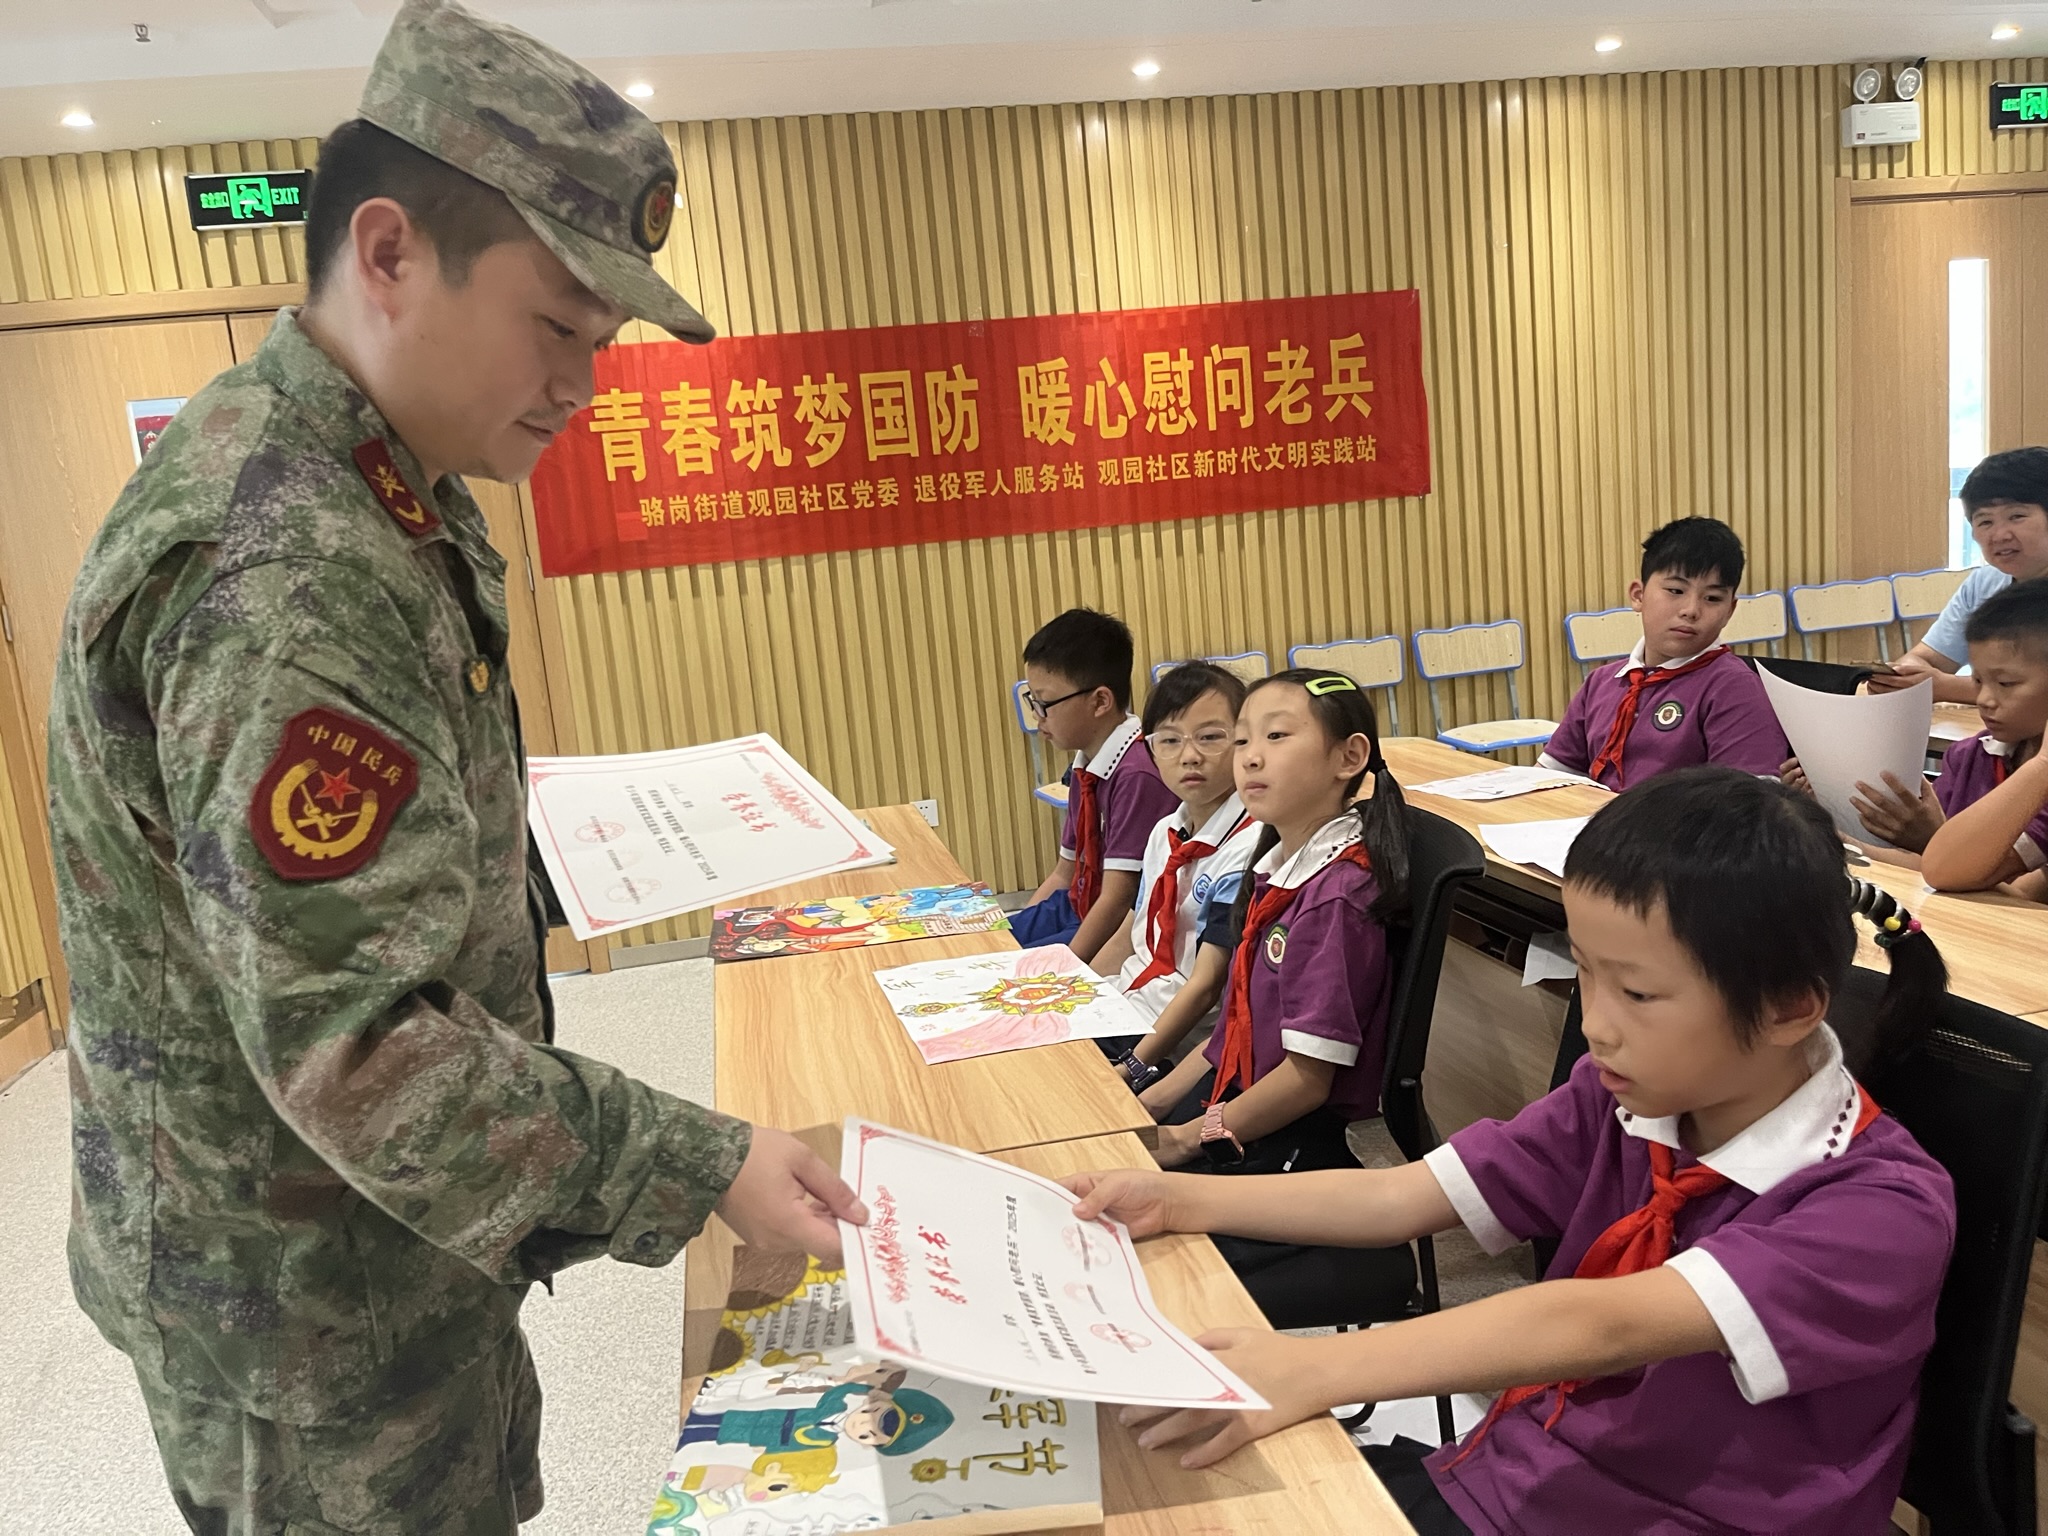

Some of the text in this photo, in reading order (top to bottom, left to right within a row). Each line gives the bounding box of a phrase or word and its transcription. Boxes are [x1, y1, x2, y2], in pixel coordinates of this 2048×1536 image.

[270, 187, 299, 205] EXIT
[589, 332, 1374, 482] 青春筑梦国防 暖心慰问老兵
[640, 435, 1377, 527] 骆岗街道观园社区党委 退役军人服务站 观园社区新时代文明实践站
[308, 724, 403, 786] 中国民兵
[973, 1388, 1068, 1476] 军节
